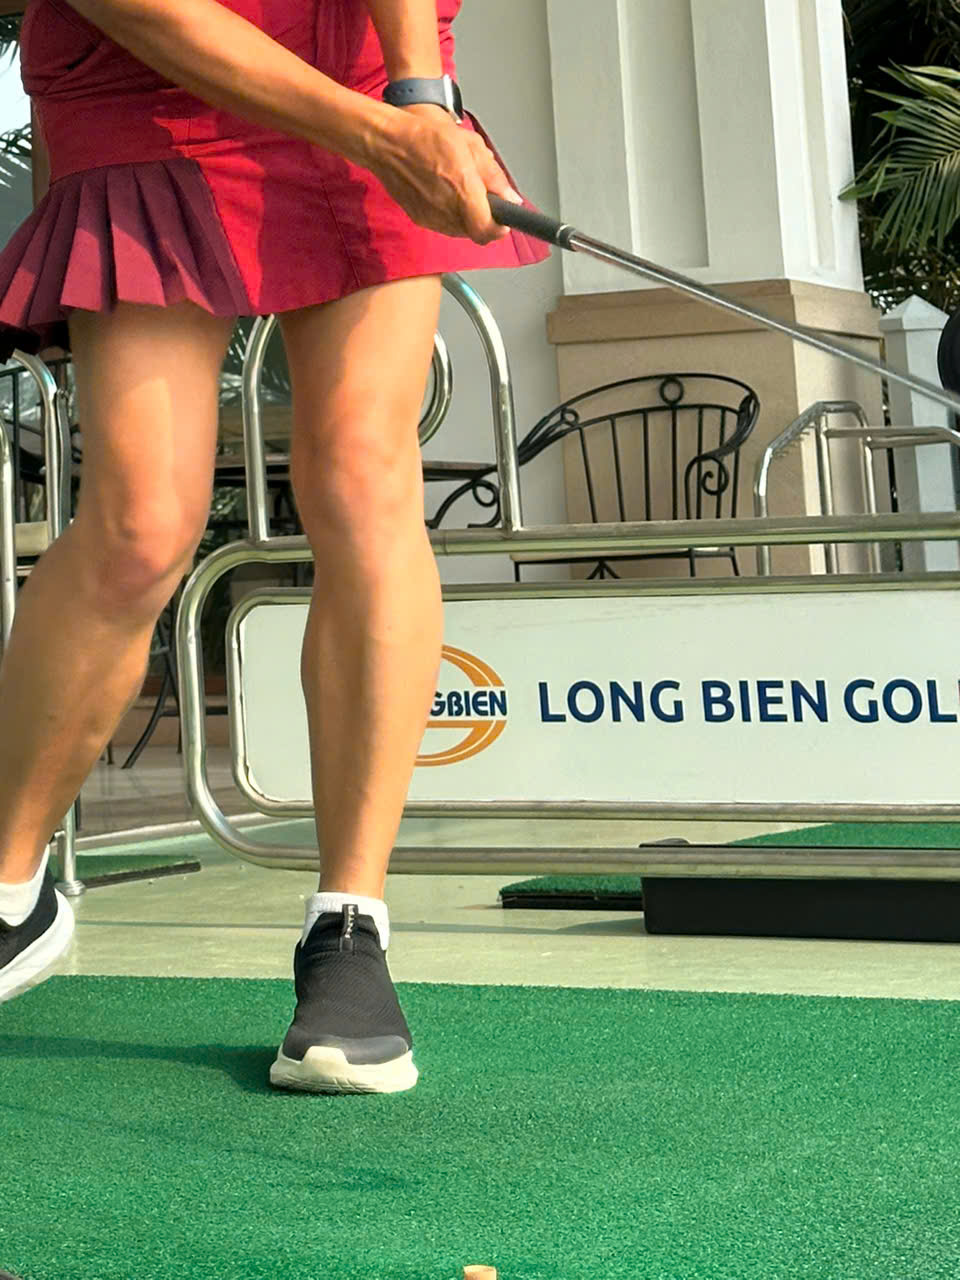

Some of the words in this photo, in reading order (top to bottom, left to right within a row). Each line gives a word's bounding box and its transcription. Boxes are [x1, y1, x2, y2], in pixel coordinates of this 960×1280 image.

[430, 690, 508, 717] GBIEN
[538, 680, 684, 723] LONG
[701, 679, 829, 723] BIEN
[843, 678, 960, 723] GOL
